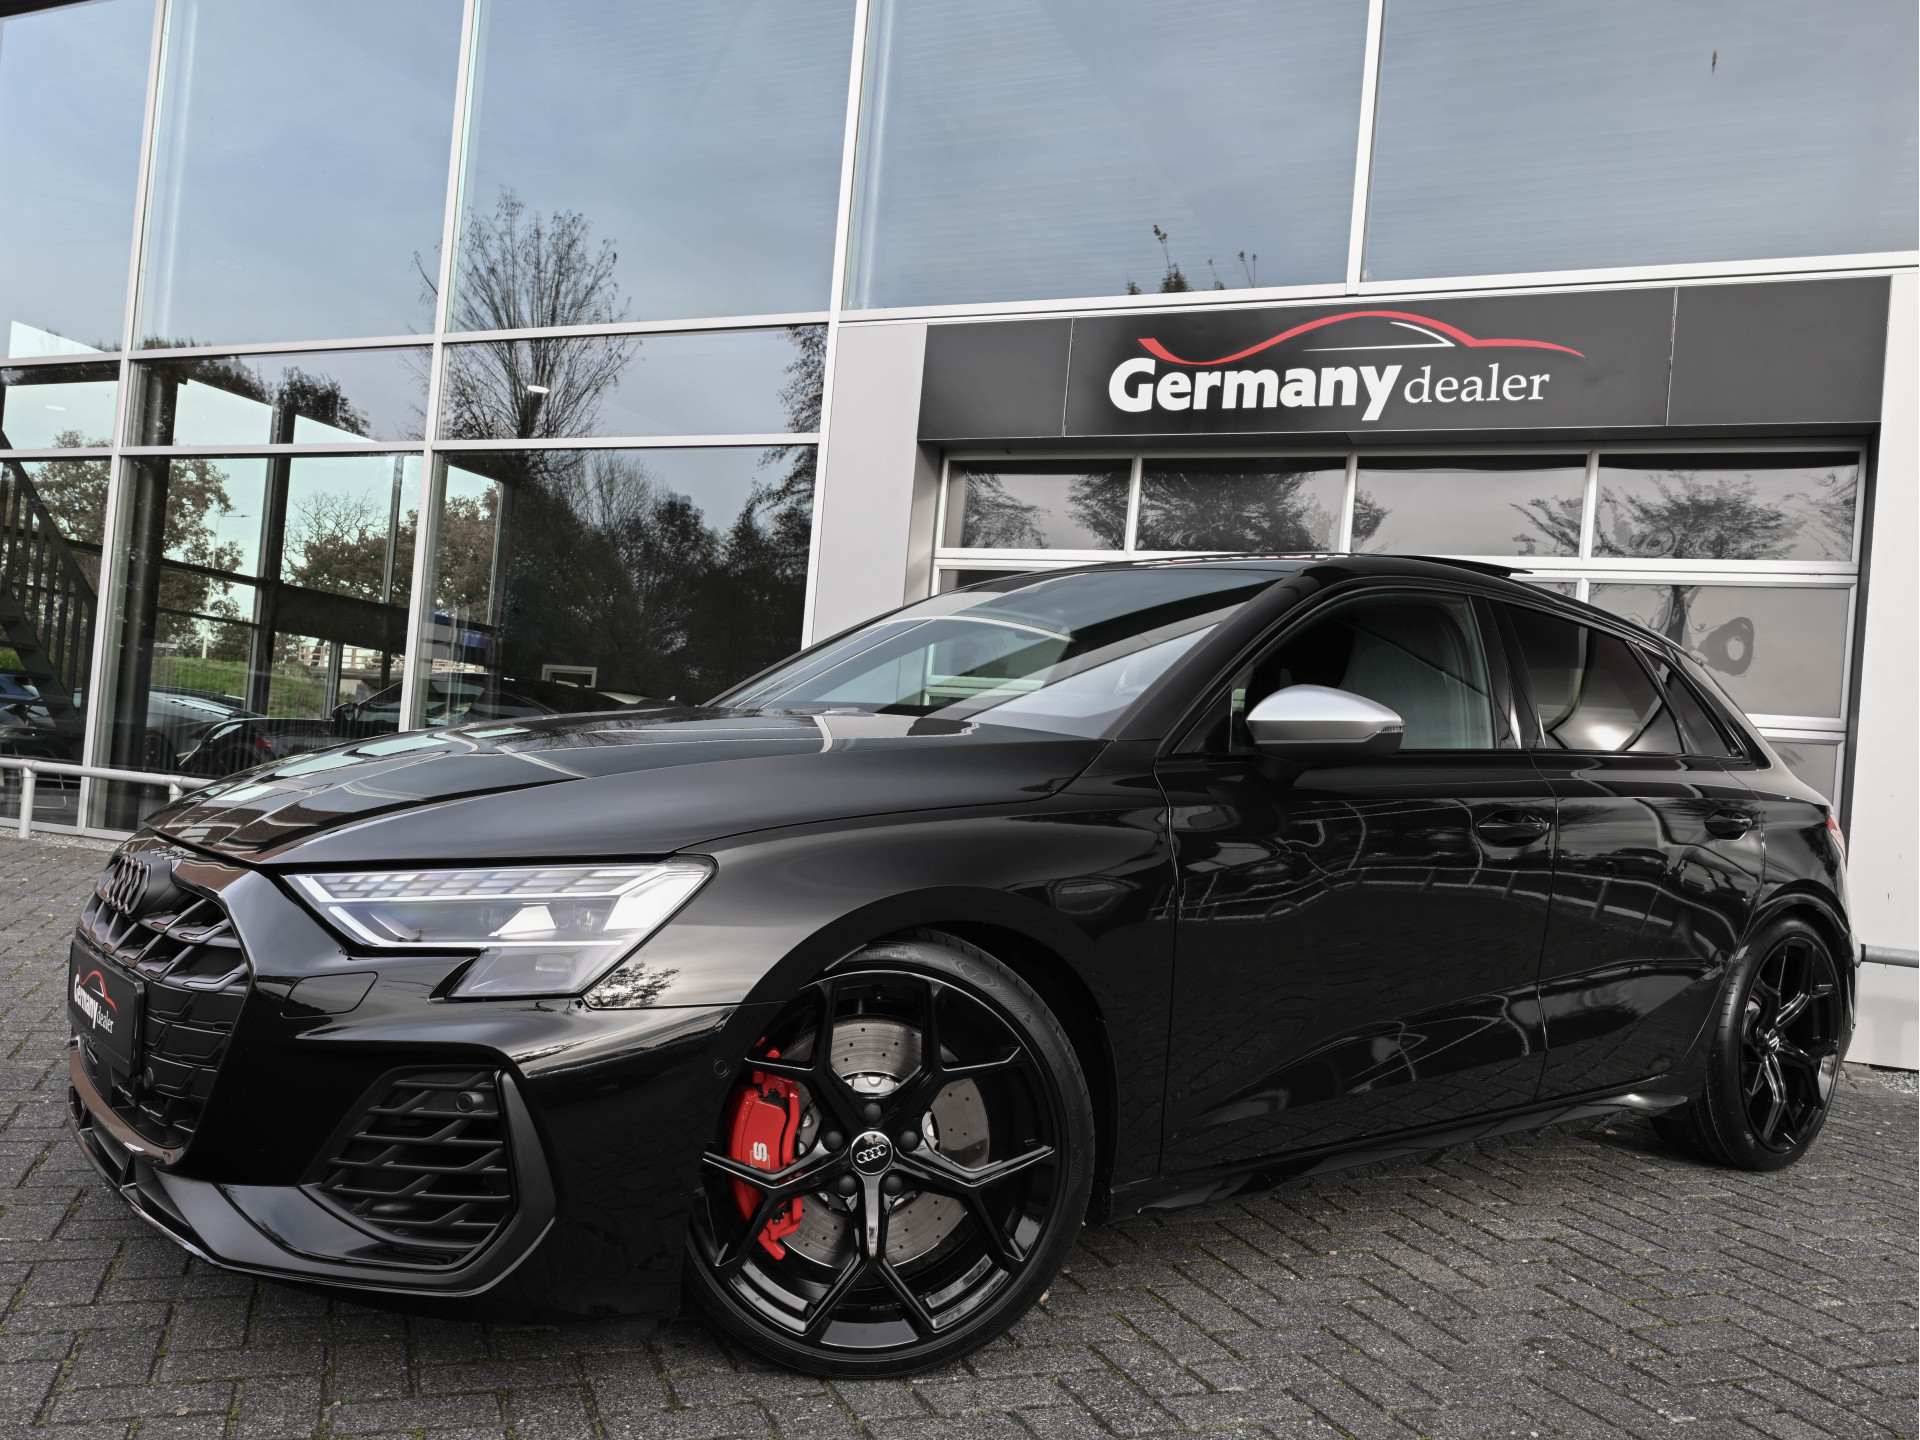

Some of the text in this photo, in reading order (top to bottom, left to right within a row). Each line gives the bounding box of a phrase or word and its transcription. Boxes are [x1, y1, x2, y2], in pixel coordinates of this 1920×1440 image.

[1108, 357, 1550, 421] Germany dealer
[74, 973, 114, 1033] Germany dealer
[753, 1141, 767, 1162] S
